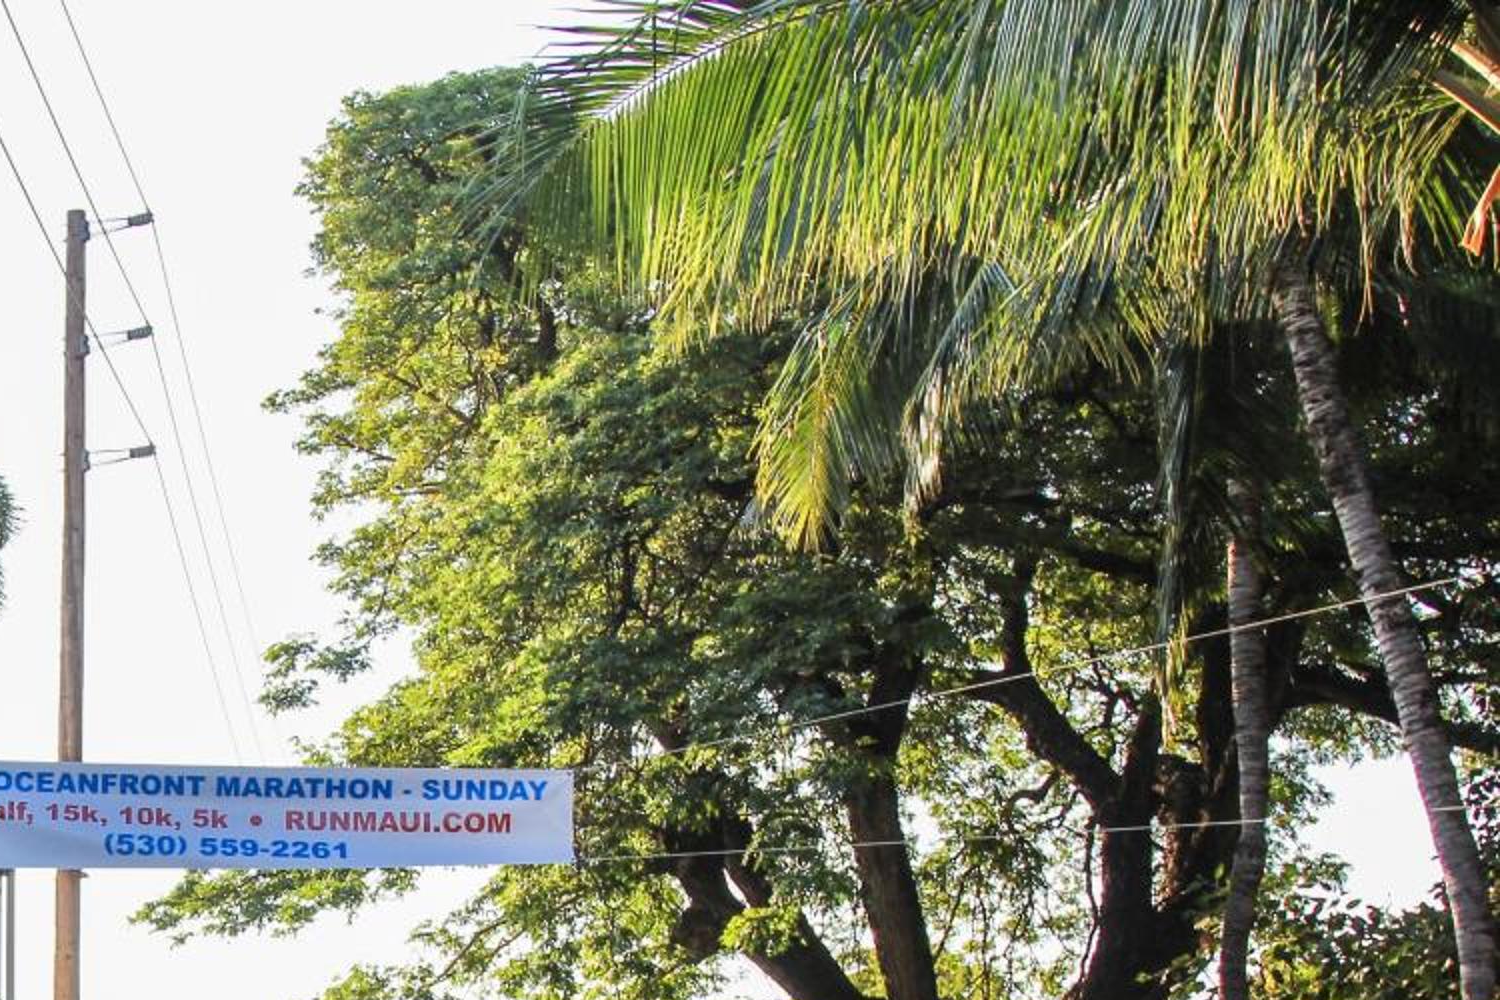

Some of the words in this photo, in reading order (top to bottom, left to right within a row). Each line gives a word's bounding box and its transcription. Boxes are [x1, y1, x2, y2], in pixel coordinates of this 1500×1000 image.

[215, 775, 393, 800] MARATHON
[422, 779, 548, 801] SUNDAY
[46, 802, 108, 827] 15k,
[119, 805, 182, 830] 10k,
[193, 808, 229, 829] 5k
[285, 809, 513, 834] RUNMAUI.COM
[103, 833, 188, 857] (530)
[199, 836, 349, 860] 559-2261
